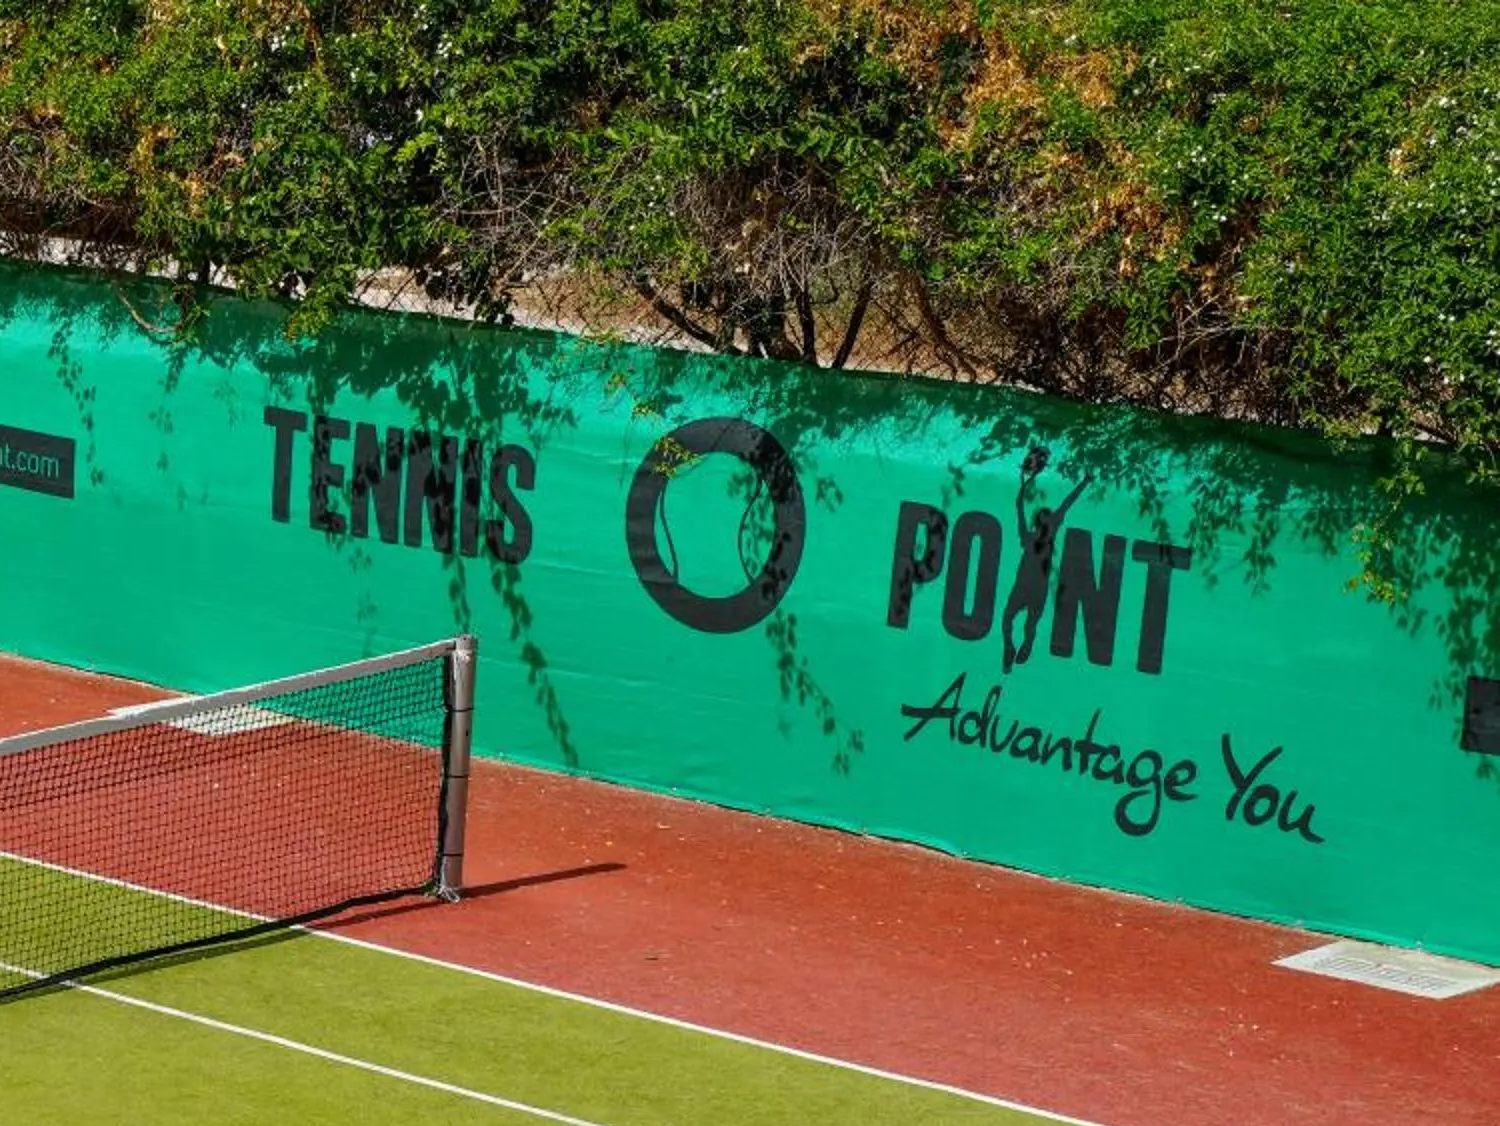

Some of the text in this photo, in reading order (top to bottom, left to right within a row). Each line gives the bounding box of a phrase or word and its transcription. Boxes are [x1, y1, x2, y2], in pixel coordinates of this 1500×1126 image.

[264, 405, 536, 566] TENNIS
[901, 672, 1325, 844] Advantage You
